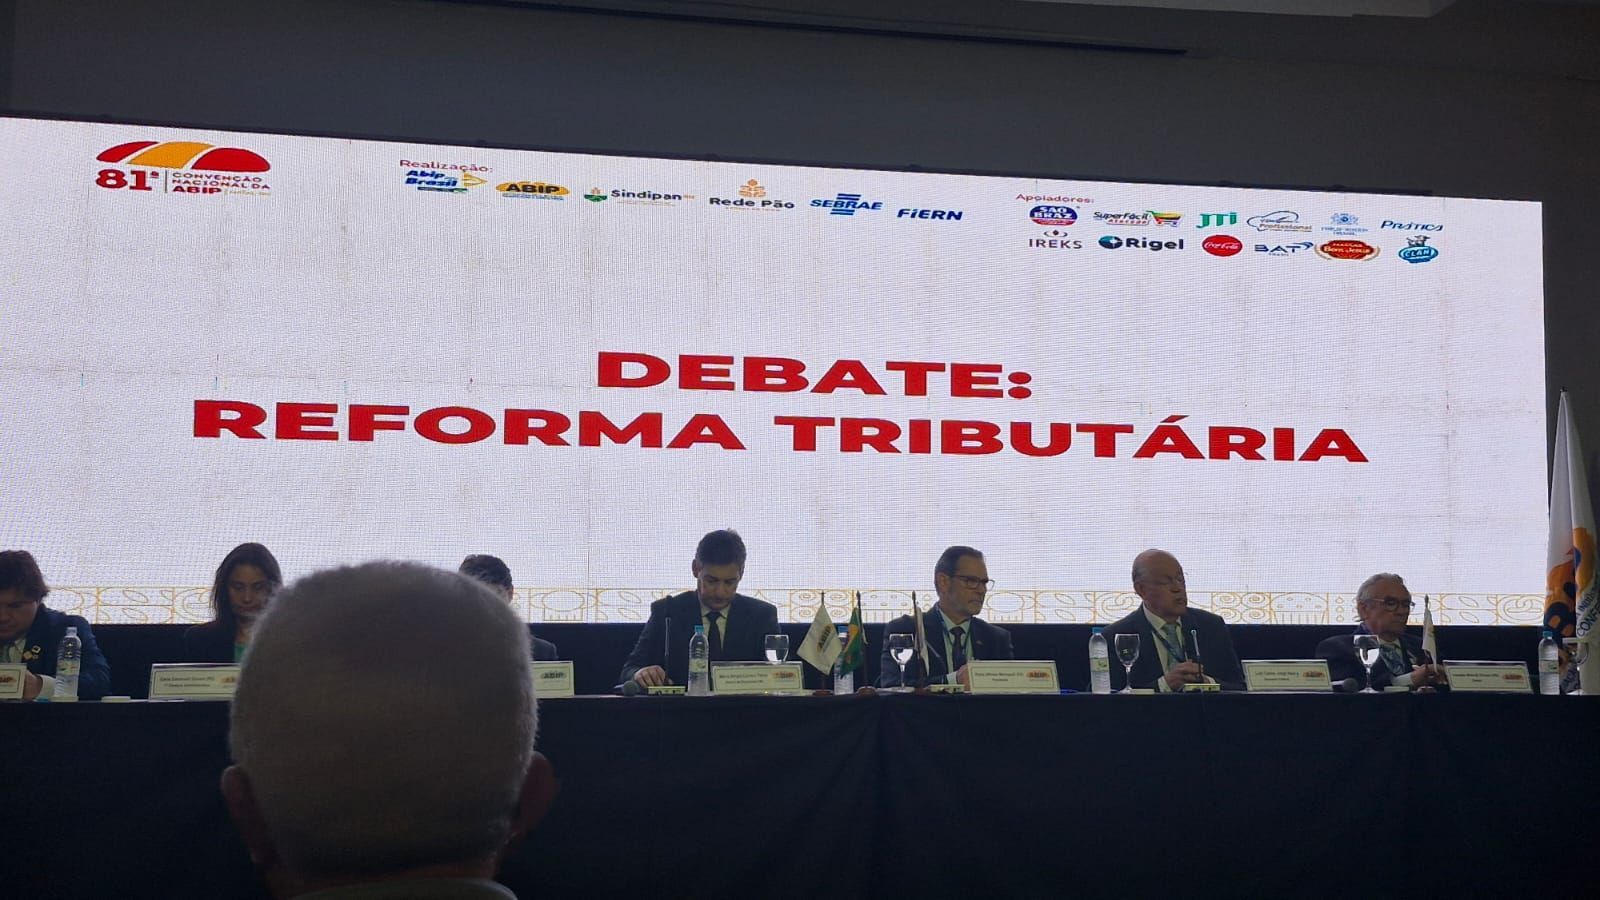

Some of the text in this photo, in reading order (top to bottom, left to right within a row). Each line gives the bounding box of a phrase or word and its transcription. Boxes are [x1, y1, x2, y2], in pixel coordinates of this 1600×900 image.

[400, 159, 493, 173] Realização:
[172, 172, 263, 184] CONVENÇÃO
[406, 170, 446, 180] Abip
[172, 179, 248, 189] NACIONAL
[405, 177, 458, 187] Brasil
[172, 185, 222, 194] ABIP
[506, 183, 560, 194] ABIP
[611, 189, 682, 201] Sindipan
[1015, 193, 1094, 204] Apoiadores:
[709, 197, 750, 207] Rede
[761, 199, 795, 209] Pão
[810, 199, 883, 210] SEBRAE
[1029, 238, 1082, 249] IREKS
[1126, 237, 1184, 251] Rigel
[1254, 244, 1302, 253] BAT
[598, 351, 1032, 400] DEBATE:
[193, 399, 1369, 462] REFORMA TRIBUTÁRIA
